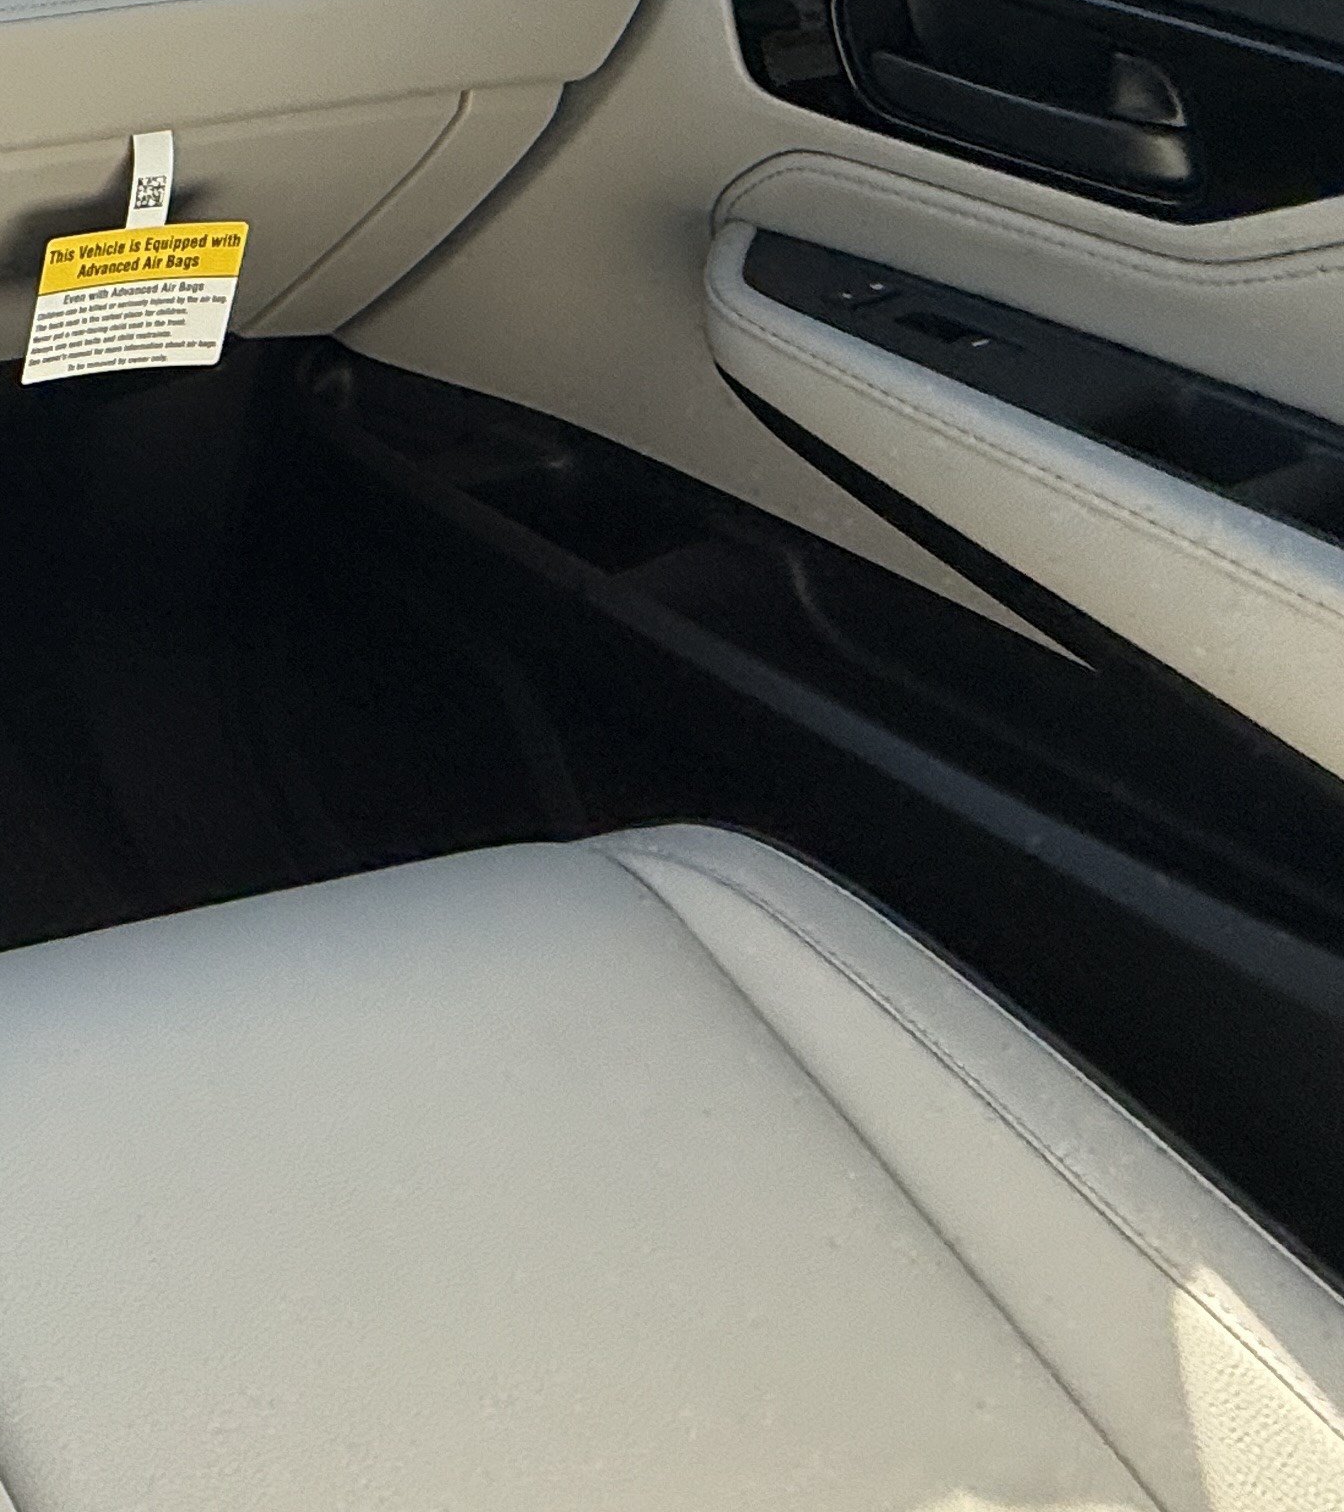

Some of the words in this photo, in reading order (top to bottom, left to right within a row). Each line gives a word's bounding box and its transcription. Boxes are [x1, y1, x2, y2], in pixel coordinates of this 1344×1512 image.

[50, 248, 76, 265] This
[79, 242, 126, 260] Vehicle
[145, 234, 208, 253] Equipped
[211, 233, 242, 248] with
[76, 257, 140, 279] Advanced
[142, 256, 163, 270] Air
[165, 255, 200, 271] Bags
[63, 294, 87, 305] Even
[88, 289, 109, 301] with
[111, 285, 159, 298] Advanced
[161, 283, 177, 293] Air
[179, 282, 205, 293] Bags
